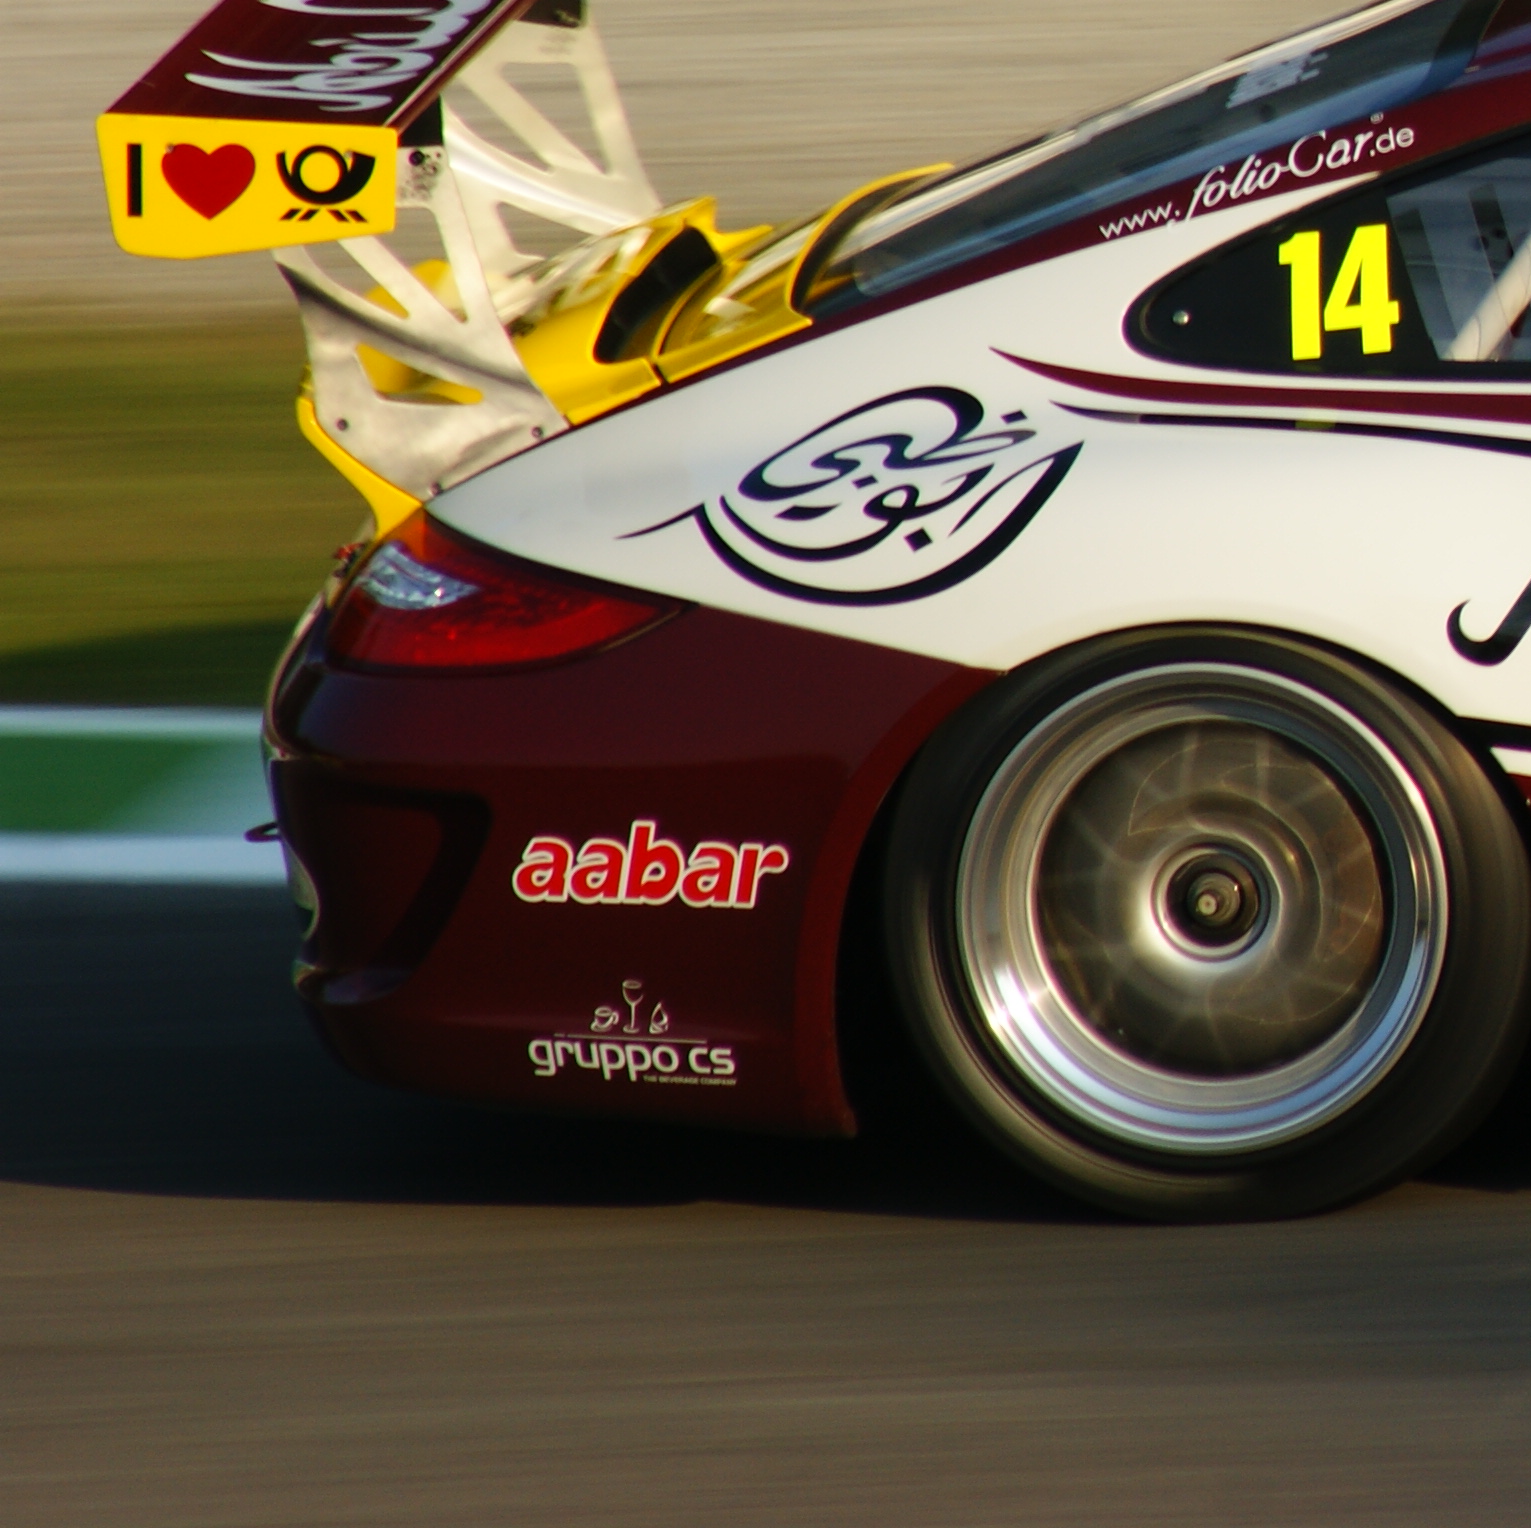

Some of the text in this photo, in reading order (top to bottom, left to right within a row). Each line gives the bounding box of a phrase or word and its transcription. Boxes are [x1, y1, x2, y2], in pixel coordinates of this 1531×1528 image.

[126, 143, 143, 218] I
[1278, 223, 1400, 360] 14
[512, 820, 789, 909] aabar
[528, 1039, 736, 1082] gruppo cs
